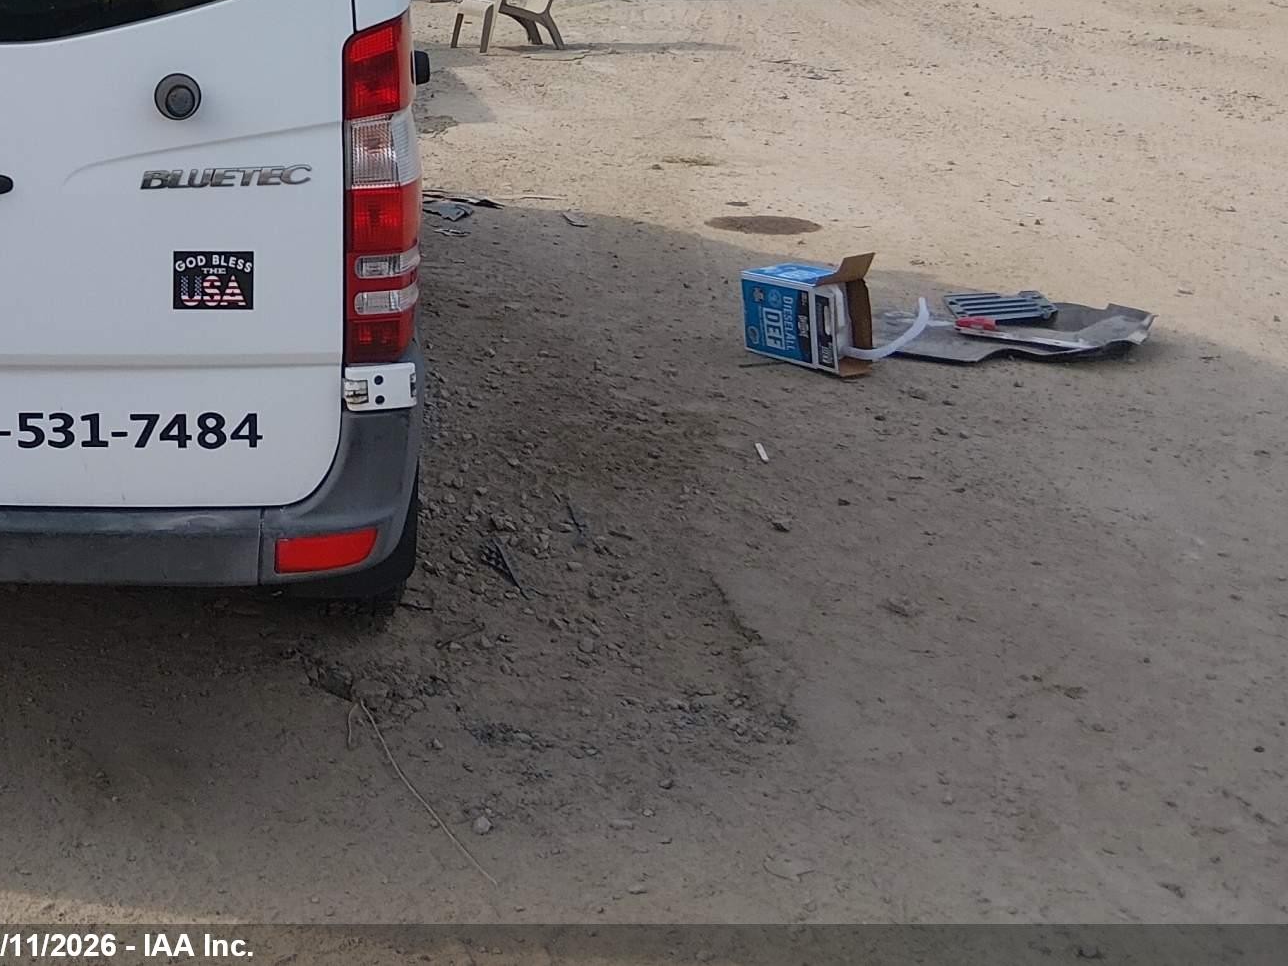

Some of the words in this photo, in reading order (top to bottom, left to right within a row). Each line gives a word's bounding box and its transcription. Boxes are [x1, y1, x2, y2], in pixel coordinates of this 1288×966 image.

[140, 164, 313, 189] BLUETEC
[175, 255, 206, 272] GOD
[212, 254, 252, 273] BLESS
[201, 267, 227, 275] THE
[180, 275, 247, 306] USA
[765, 311, 781, 349] DEF
